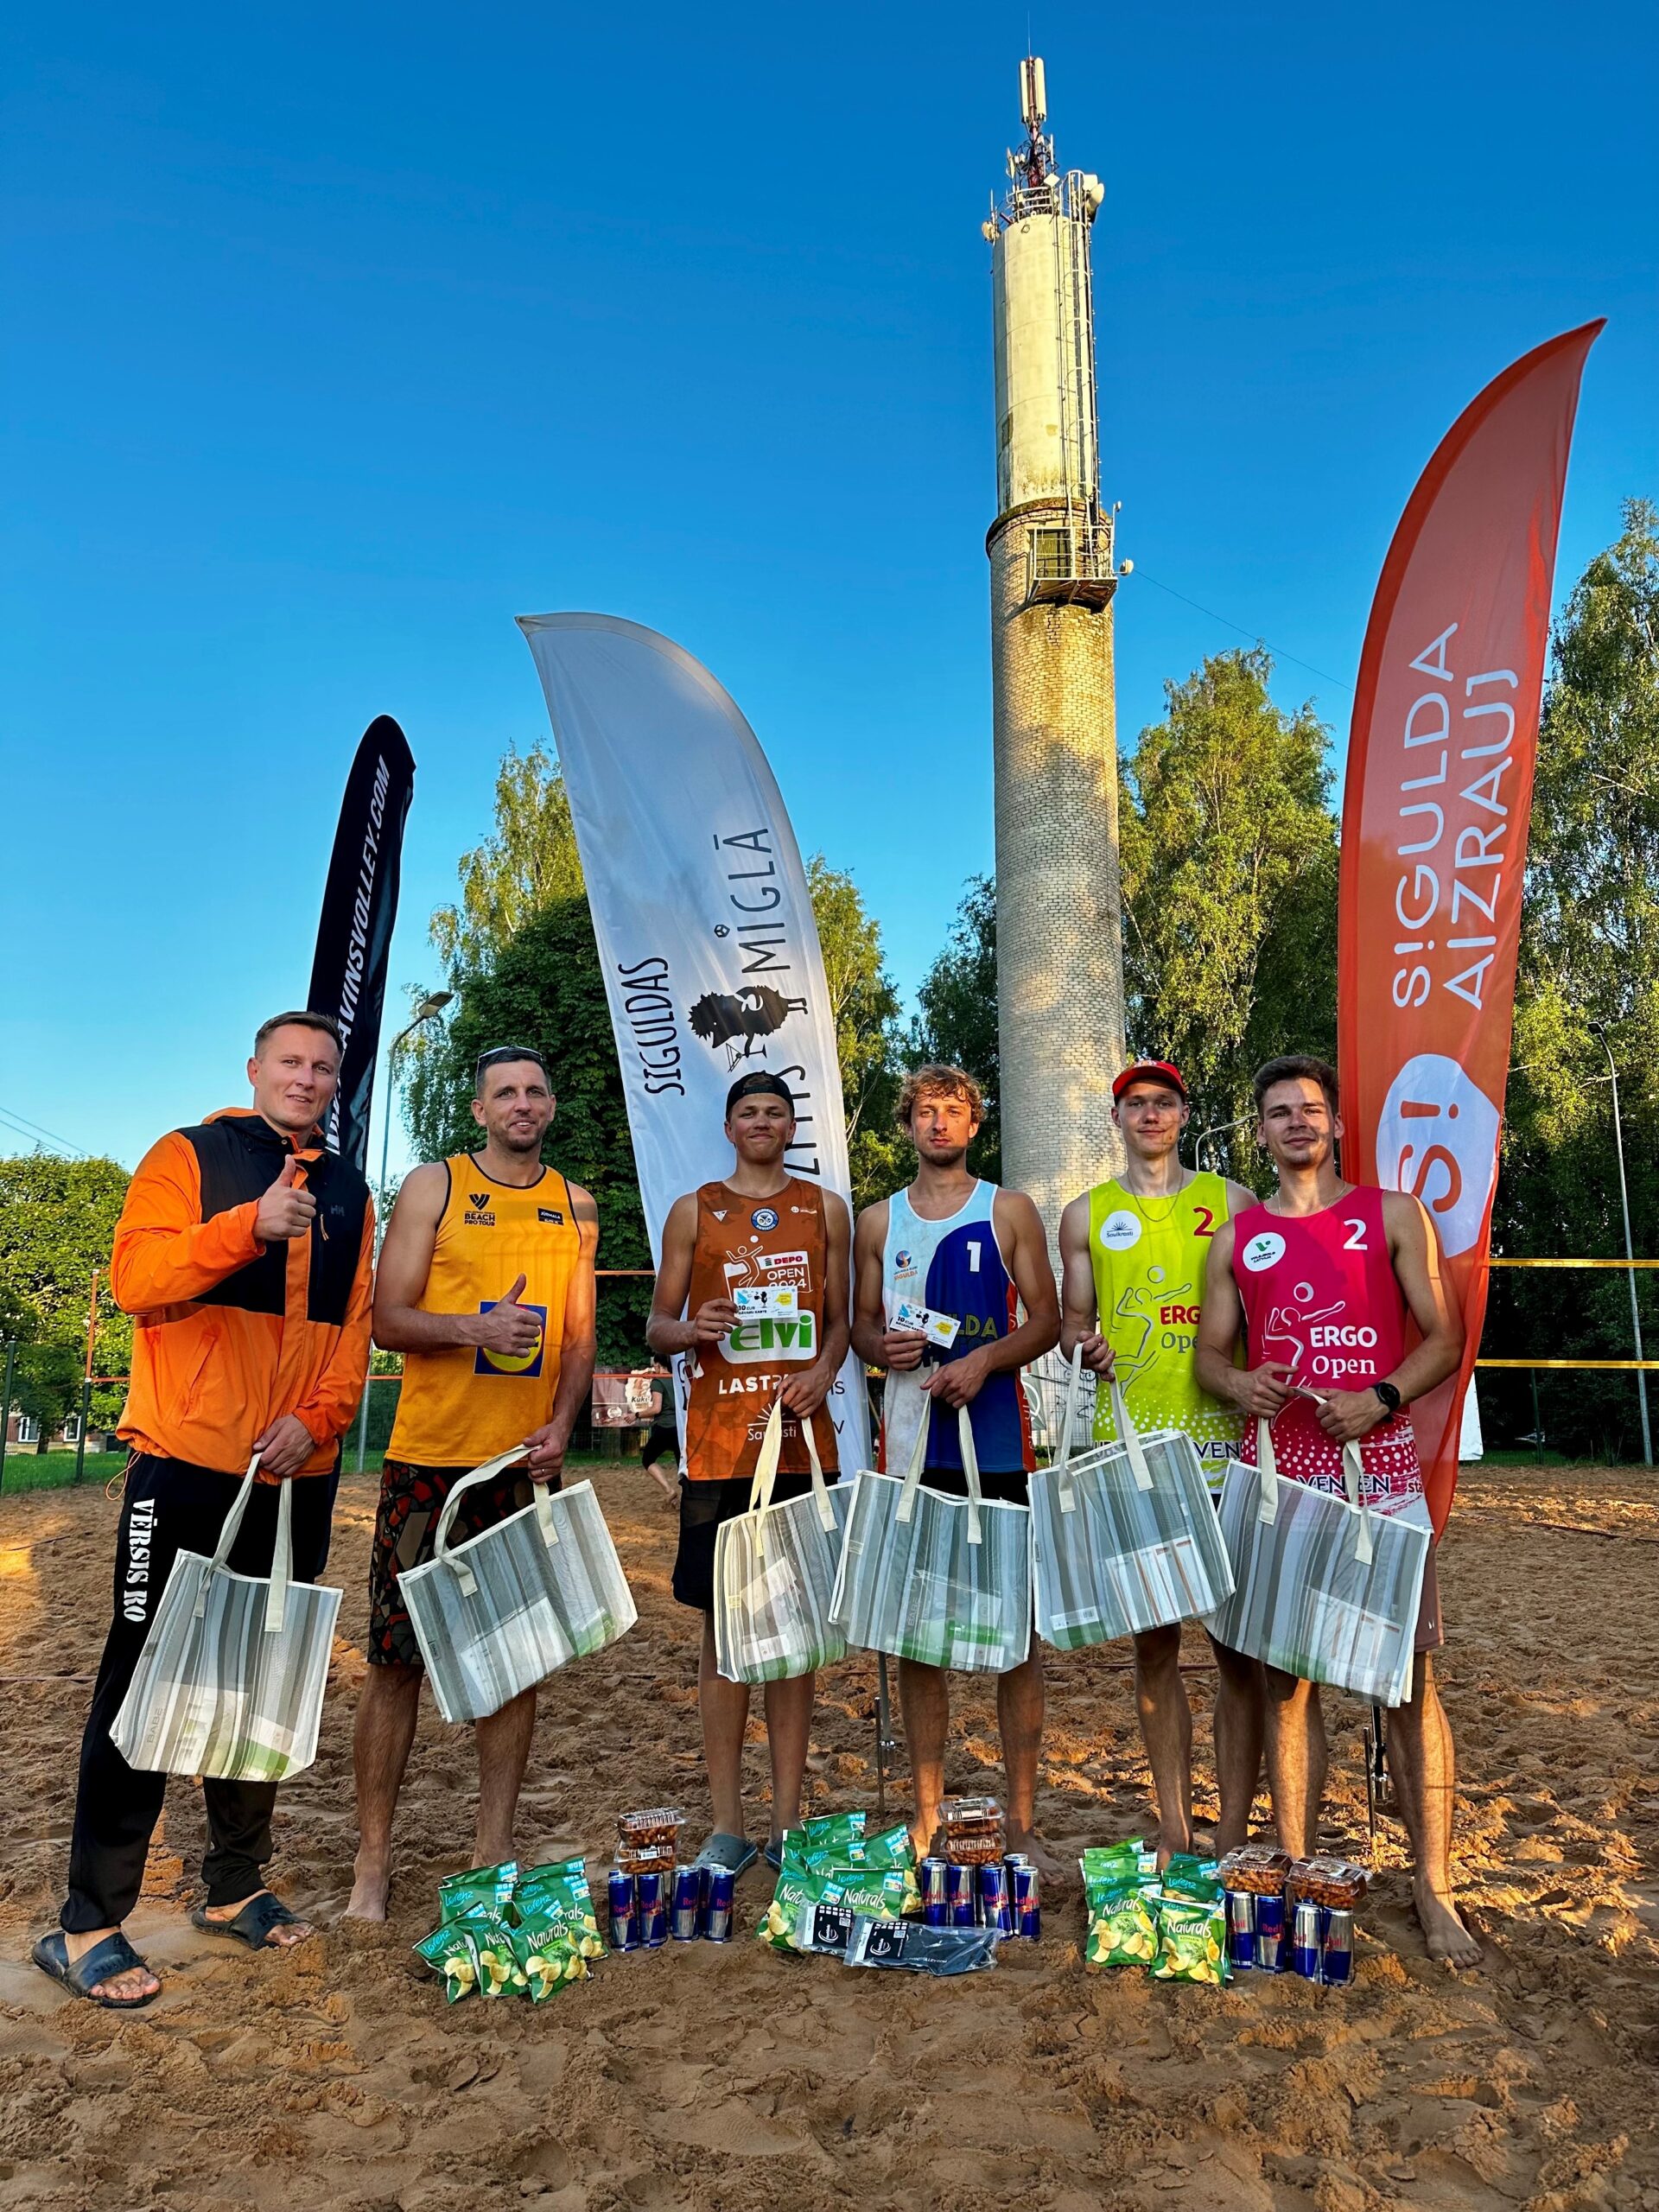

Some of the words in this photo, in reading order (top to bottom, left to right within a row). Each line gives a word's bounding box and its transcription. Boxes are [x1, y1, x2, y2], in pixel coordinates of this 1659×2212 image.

[618, 957, 685, 1096] SIGULDAS
[464, 1212, 496, 1222] BEACH
[1193, 1206, 1214, 1237] 2
[1343, 1218, 1368, 1250] 2
[773, 1255, 804, 1265] DEPO
[966, 1241, 982, 1273] 1
[766, 1267, 804, 1281] OPEN
[1160, 1305, 1201, 1325] ERG
[1160, 1332, 1198, 1354] Ope
[1309, 1325, 1378, 1349] ERGO
[1311, 1354, 1376, 1380] Open
[126, 1498, 157, 1585] VĒRSIS
[1168, 1877, 1197, 1890] Lorenz
[444, 1890, 474, 1907] Lorenz
[523, 1894, 552, 1916] Lorenz
[843, 1886, 887, 1910] Naturals
[1102, 1897, 1142, 1918] Naturals
[526, 1919, 569, 1954] Naturals
[1166, 1917, 1212, 1938] Naturals
[423, 1929, 452, 1955] Lorenz
